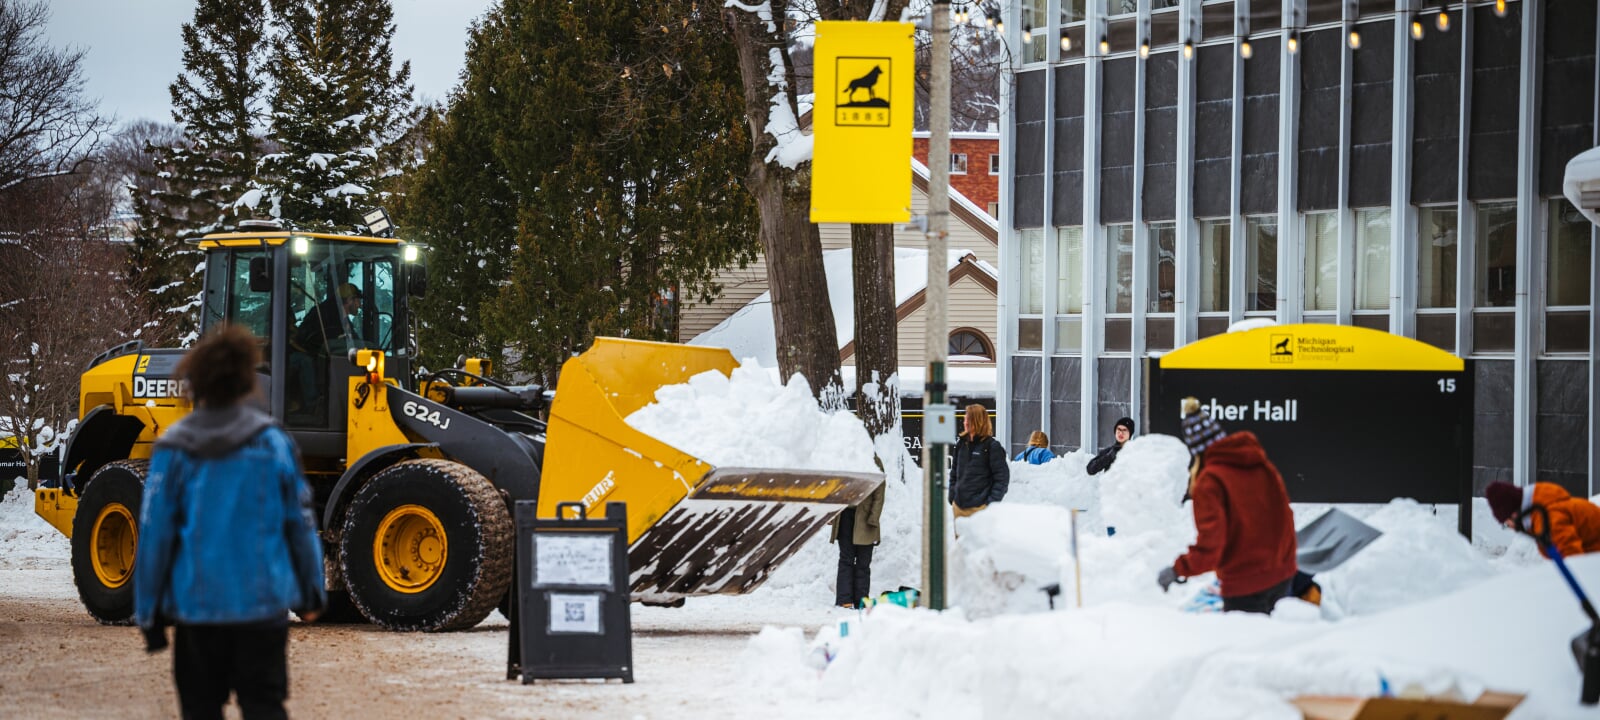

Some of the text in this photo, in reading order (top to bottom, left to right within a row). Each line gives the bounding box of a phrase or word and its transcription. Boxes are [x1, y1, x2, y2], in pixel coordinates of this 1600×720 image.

[842, 112, 884, 121] 1885
[1297, 337, 1336, 346] Michigan
[1297, 346, 1355, 354] Technological
[1298, 354, 1340, 362] University
[1437, 378, 1456, 393] 15
[1180, 398, 1298, 421] sher Hall
[403, 401, 450, 429] 624J
